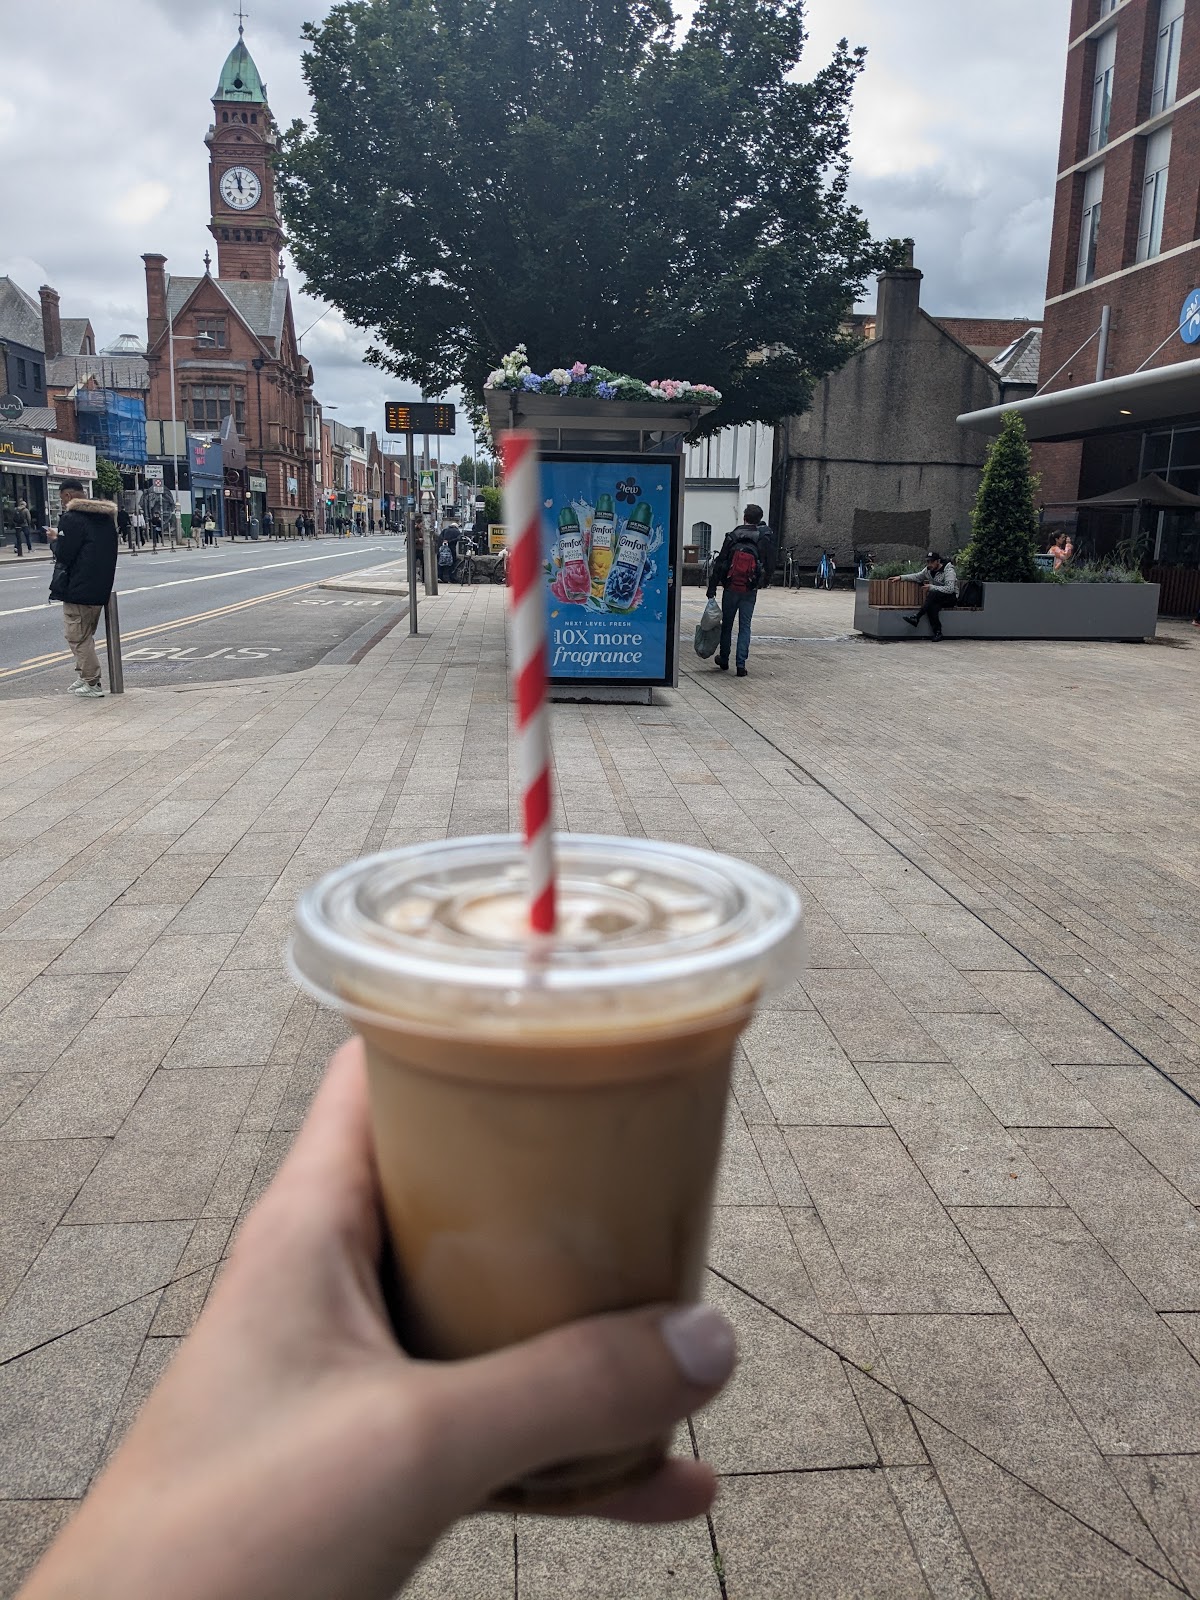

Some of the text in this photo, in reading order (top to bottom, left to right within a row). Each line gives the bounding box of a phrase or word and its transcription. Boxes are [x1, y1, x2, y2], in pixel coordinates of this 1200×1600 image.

[619, 483, 639, 494] new
[555, 629, 589, 645] 10X
[593, 633, 642, 646] more
[121, 647, 283, 661] BUS
[552, 646, 643, 667] fragrance
